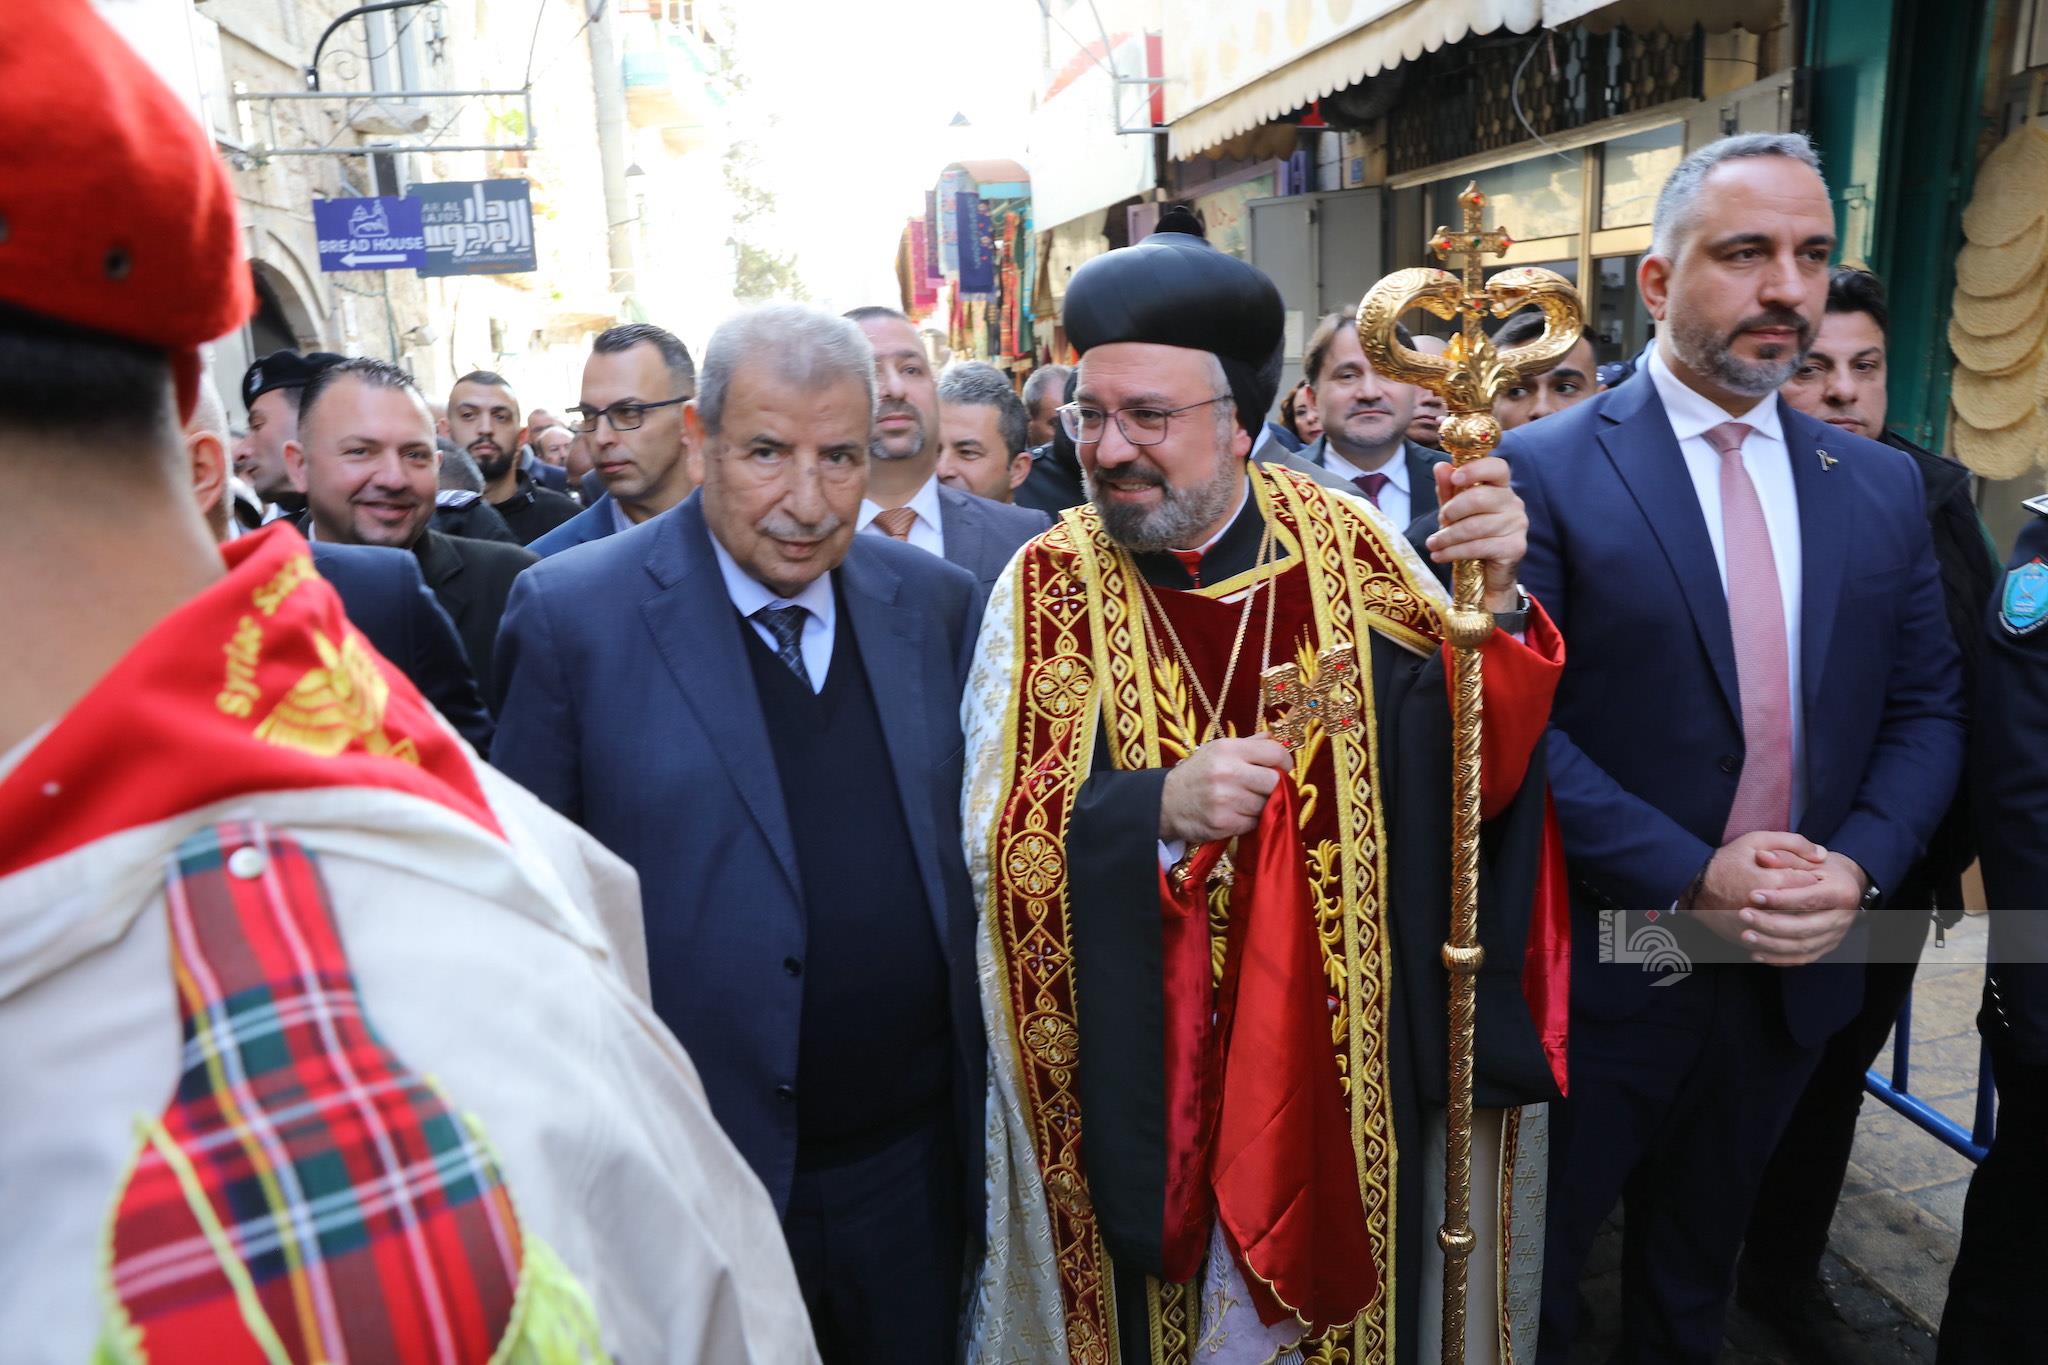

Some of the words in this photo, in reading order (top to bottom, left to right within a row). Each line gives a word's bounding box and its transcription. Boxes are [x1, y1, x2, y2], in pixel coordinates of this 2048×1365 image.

[421, 202, 440, 214] AR
[464, 183, 508, 223] دار
[319, 239, 371, 254] BREAD
[372, 236, 425, 252] HOUSE
